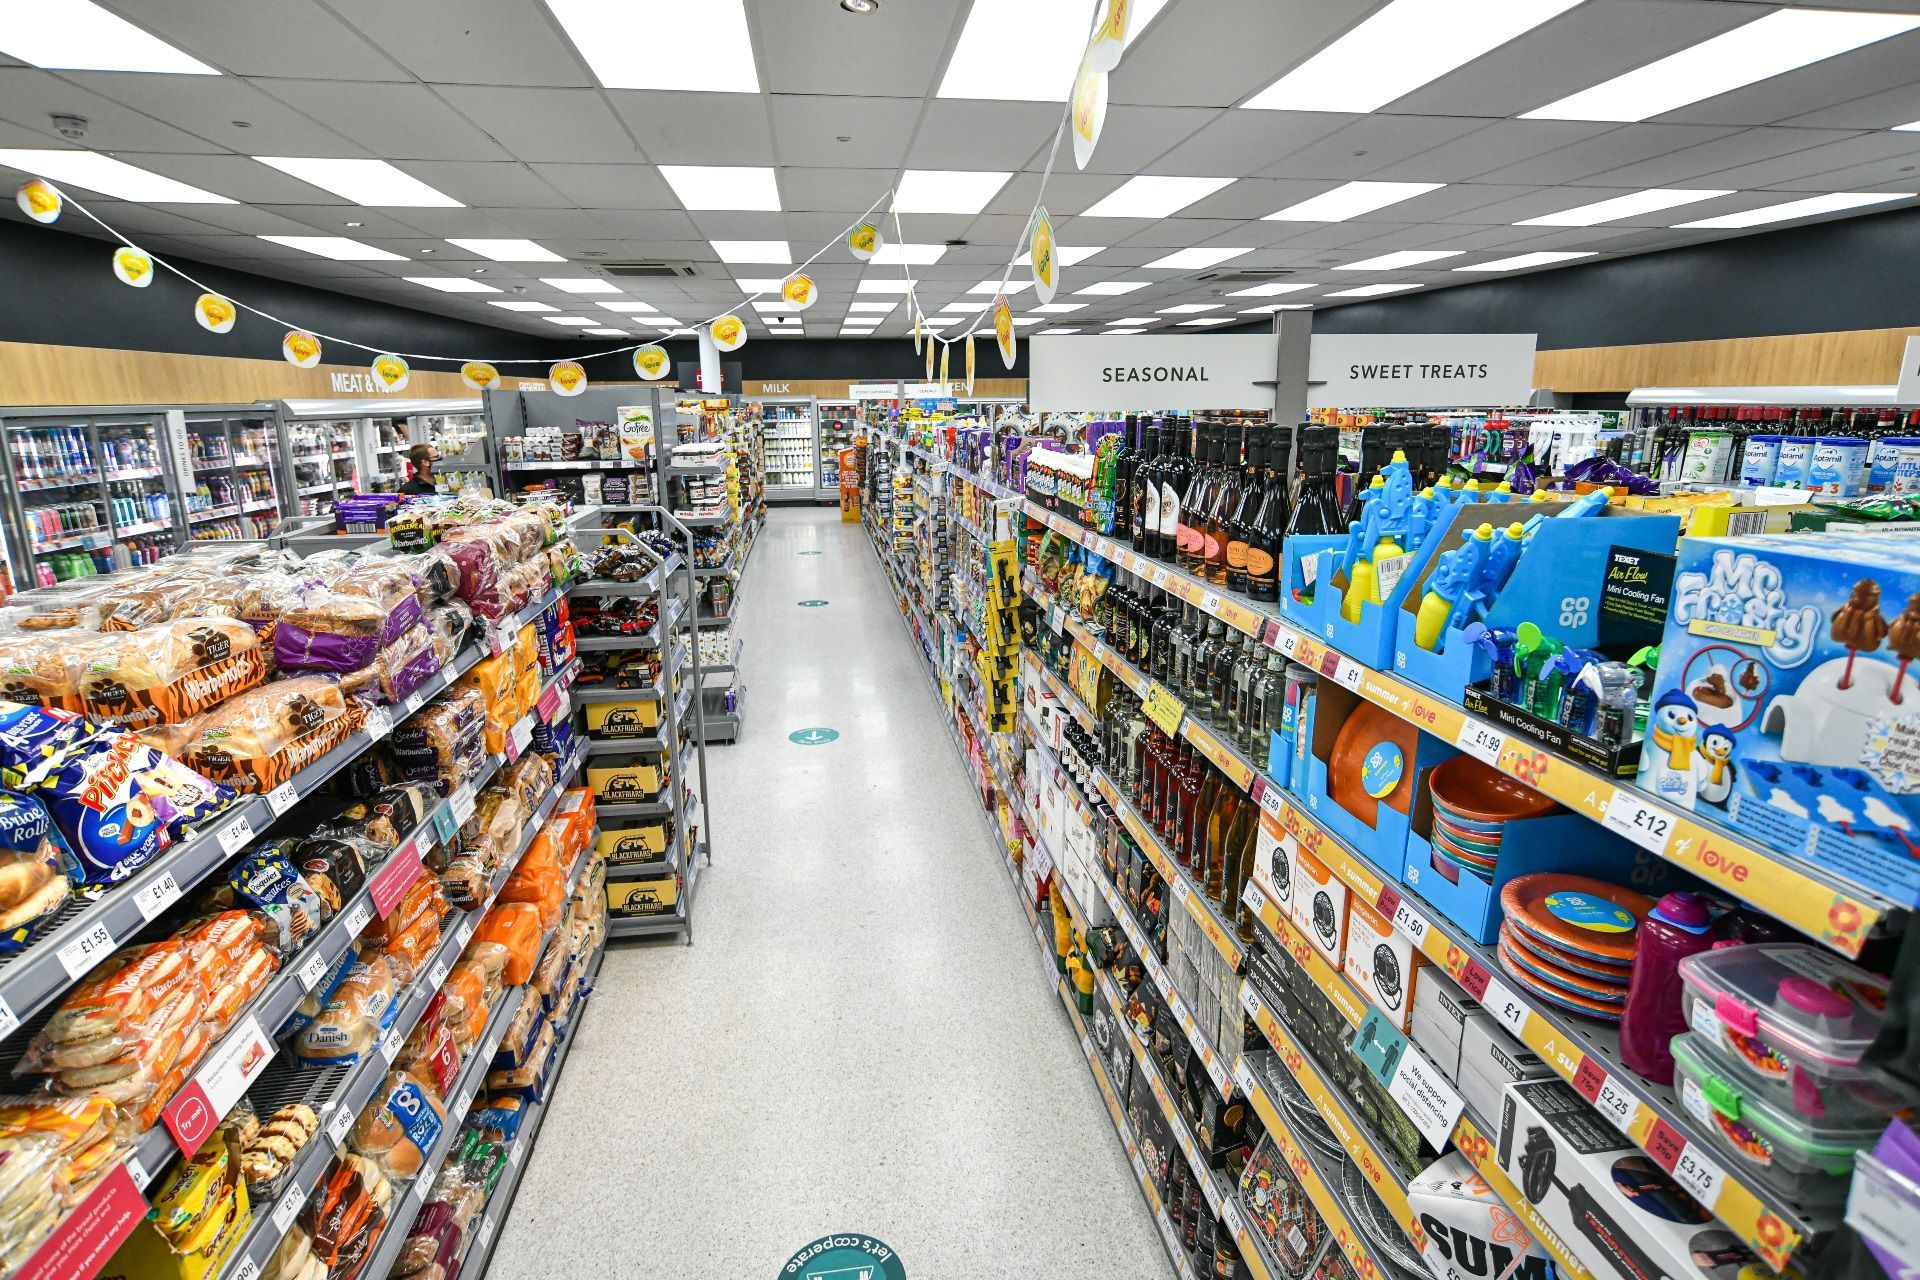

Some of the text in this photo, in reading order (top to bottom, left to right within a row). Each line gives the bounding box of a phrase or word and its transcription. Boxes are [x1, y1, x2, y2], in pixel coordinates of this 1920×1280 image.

[858, 237, 874, 248] love
[791, 288, 808, 299] love
[721, 331, 738, 341] love
[294, 346, 311, 357] love
[382, 370, 399, 379] love
[644, 361, 661, 369] love
[1102, 366, 1209, 383] SEASONAL
[1349, 363, 1488, 380] SWEET TREATS
[331, 373, 362, 392] MEAT
[365, 376, 374, 392] &
[560, 376, 577, 385] love
[763, 384, 790, 393] MILK
[177, 428, 190, 477] DRINKS TO GO
[1780, 452, 1804, 460] Aptamil
[1814, 454, 1842, 463] Aptamil
[1831, 483, 1840, 494] 3
[392, 536, 428, 548] Warburtons
[1614, 554, 1640, 566] TEXET
[1608, 566, 1648, 581] Air Flow
[1713, 549, 1782, 599] Mr
[1607, 584, 1622, 595] Mini
[1622, 588, 1650, 602] Cooling
[1650, 594, 1665, 604] Fan
[1225, 607, 1238, 620] love
[1675, 572, 1821, 669] Frosty
[206, 639, 230, 654] TIGER
[1284, 638, 1294, 650] £2
[184, 655, 251, 701] Warburtons
[1349, 669, 1358, 683] £1
[14, 694, 40, 702] TIGER
[102, 688, 127, 698] TIGER
[1365, 681, 1399, 706] summer
[1411, 698, 1436, 724] love
[302, 708, 326, 723] TIGER
[395, 731, 425, 743] Seeded
[601, 722, 644, 734] BLACKFRIARS
[1500, 710, 1562, 745] Mini Cooling Fan
[288, 724, 338, 768] Warburtons
[1475, 731, 1502, 752] £1.99
[206, 754, 231, 764] TIGER
[394, 747, 433, 756] Warburtons
[280, 785, 295, 803] £1.45
[603, 788, 645, 800] BLACKFRIARS
[1262, 792, 1279, 811] £2.50
[1584, 790, 1596, 806] A
[14, 818, 49, 843] Rolls
[231, 820, 249, 839] £1.40
[1634, 809, 1669, 838] £12
[610, 849, 652, 861] BLACKFRIARS
[1675, 836, 1749, 884] of love
[111, 861, 132, 880] 4
[153, 876, 175, 899] £1.40
[251, 872, 278, 893] Pasquier
[1340, 862, 1379, 899] A summer
[623, 901, 664, 913] BLACKFRIARS
[1384, 891, 1396, 906] Low
[354, 910, 368, 926] £1.65
[1379, 900, 1394, 918] Price
[1397, 907, 1424, 937] £1.50
[80, 928, 108, 954] £1.55
[309, 959, 324, 976] £1.50
[436, 965, 446, 977] 95p
[1469, 967, 1485, 985] Low
[1255, 961, 1286, 995] DUNLOP
[1464, 977, 1482, 997] Price
[1248, 994, 1259, 1012] £25
[1327, 981, 1364, 1023] A summer
[1439, 991, 1464, 1021] INTEX
[1503, 1001, 1522, 1024] £1
[308, 1032, 348, 1044] Danish
[390, 1034, 401, 1049] 95p
[441, 1045, 450, 1065] 6
[1543, 1040, 1555, 1057] A
[1491, 1043, 1522, 1081] INTEX
[1579, 1075, 1595, 1094] 75p
[1582, 1065, 1601, 1086] Save
[1409, 1064, 1447, 1109] We support
[397, 1090, 421, 1116] 8
[1397, 1069, 1450, 1128] social distancing
[1601, 1086, 1629, 1116] £2.25
[180, 1104, 203, 1132] Try me!
[339, 1110, 351, 1128] 95p
[1316, 1094, 1381, 1183] A summer love
[1656, 1129, 1679, 1151] Save
[1653, 1141, 1672, 1162] 25p
[1679, 1154, 1713, 1190] £3.75
[161, 1163, 199, 1205] Soreen
[285, 1189, 301, 1211] £1.70
[75, 1211, 94, 1233] bread
[91, 1187, 117, 1215] products
[83, 1208, 133, 1267] you need any help.
[1517, 1198, 1586, 1274] A summer
[786, 1236, 893, 1273] let's cooperate
